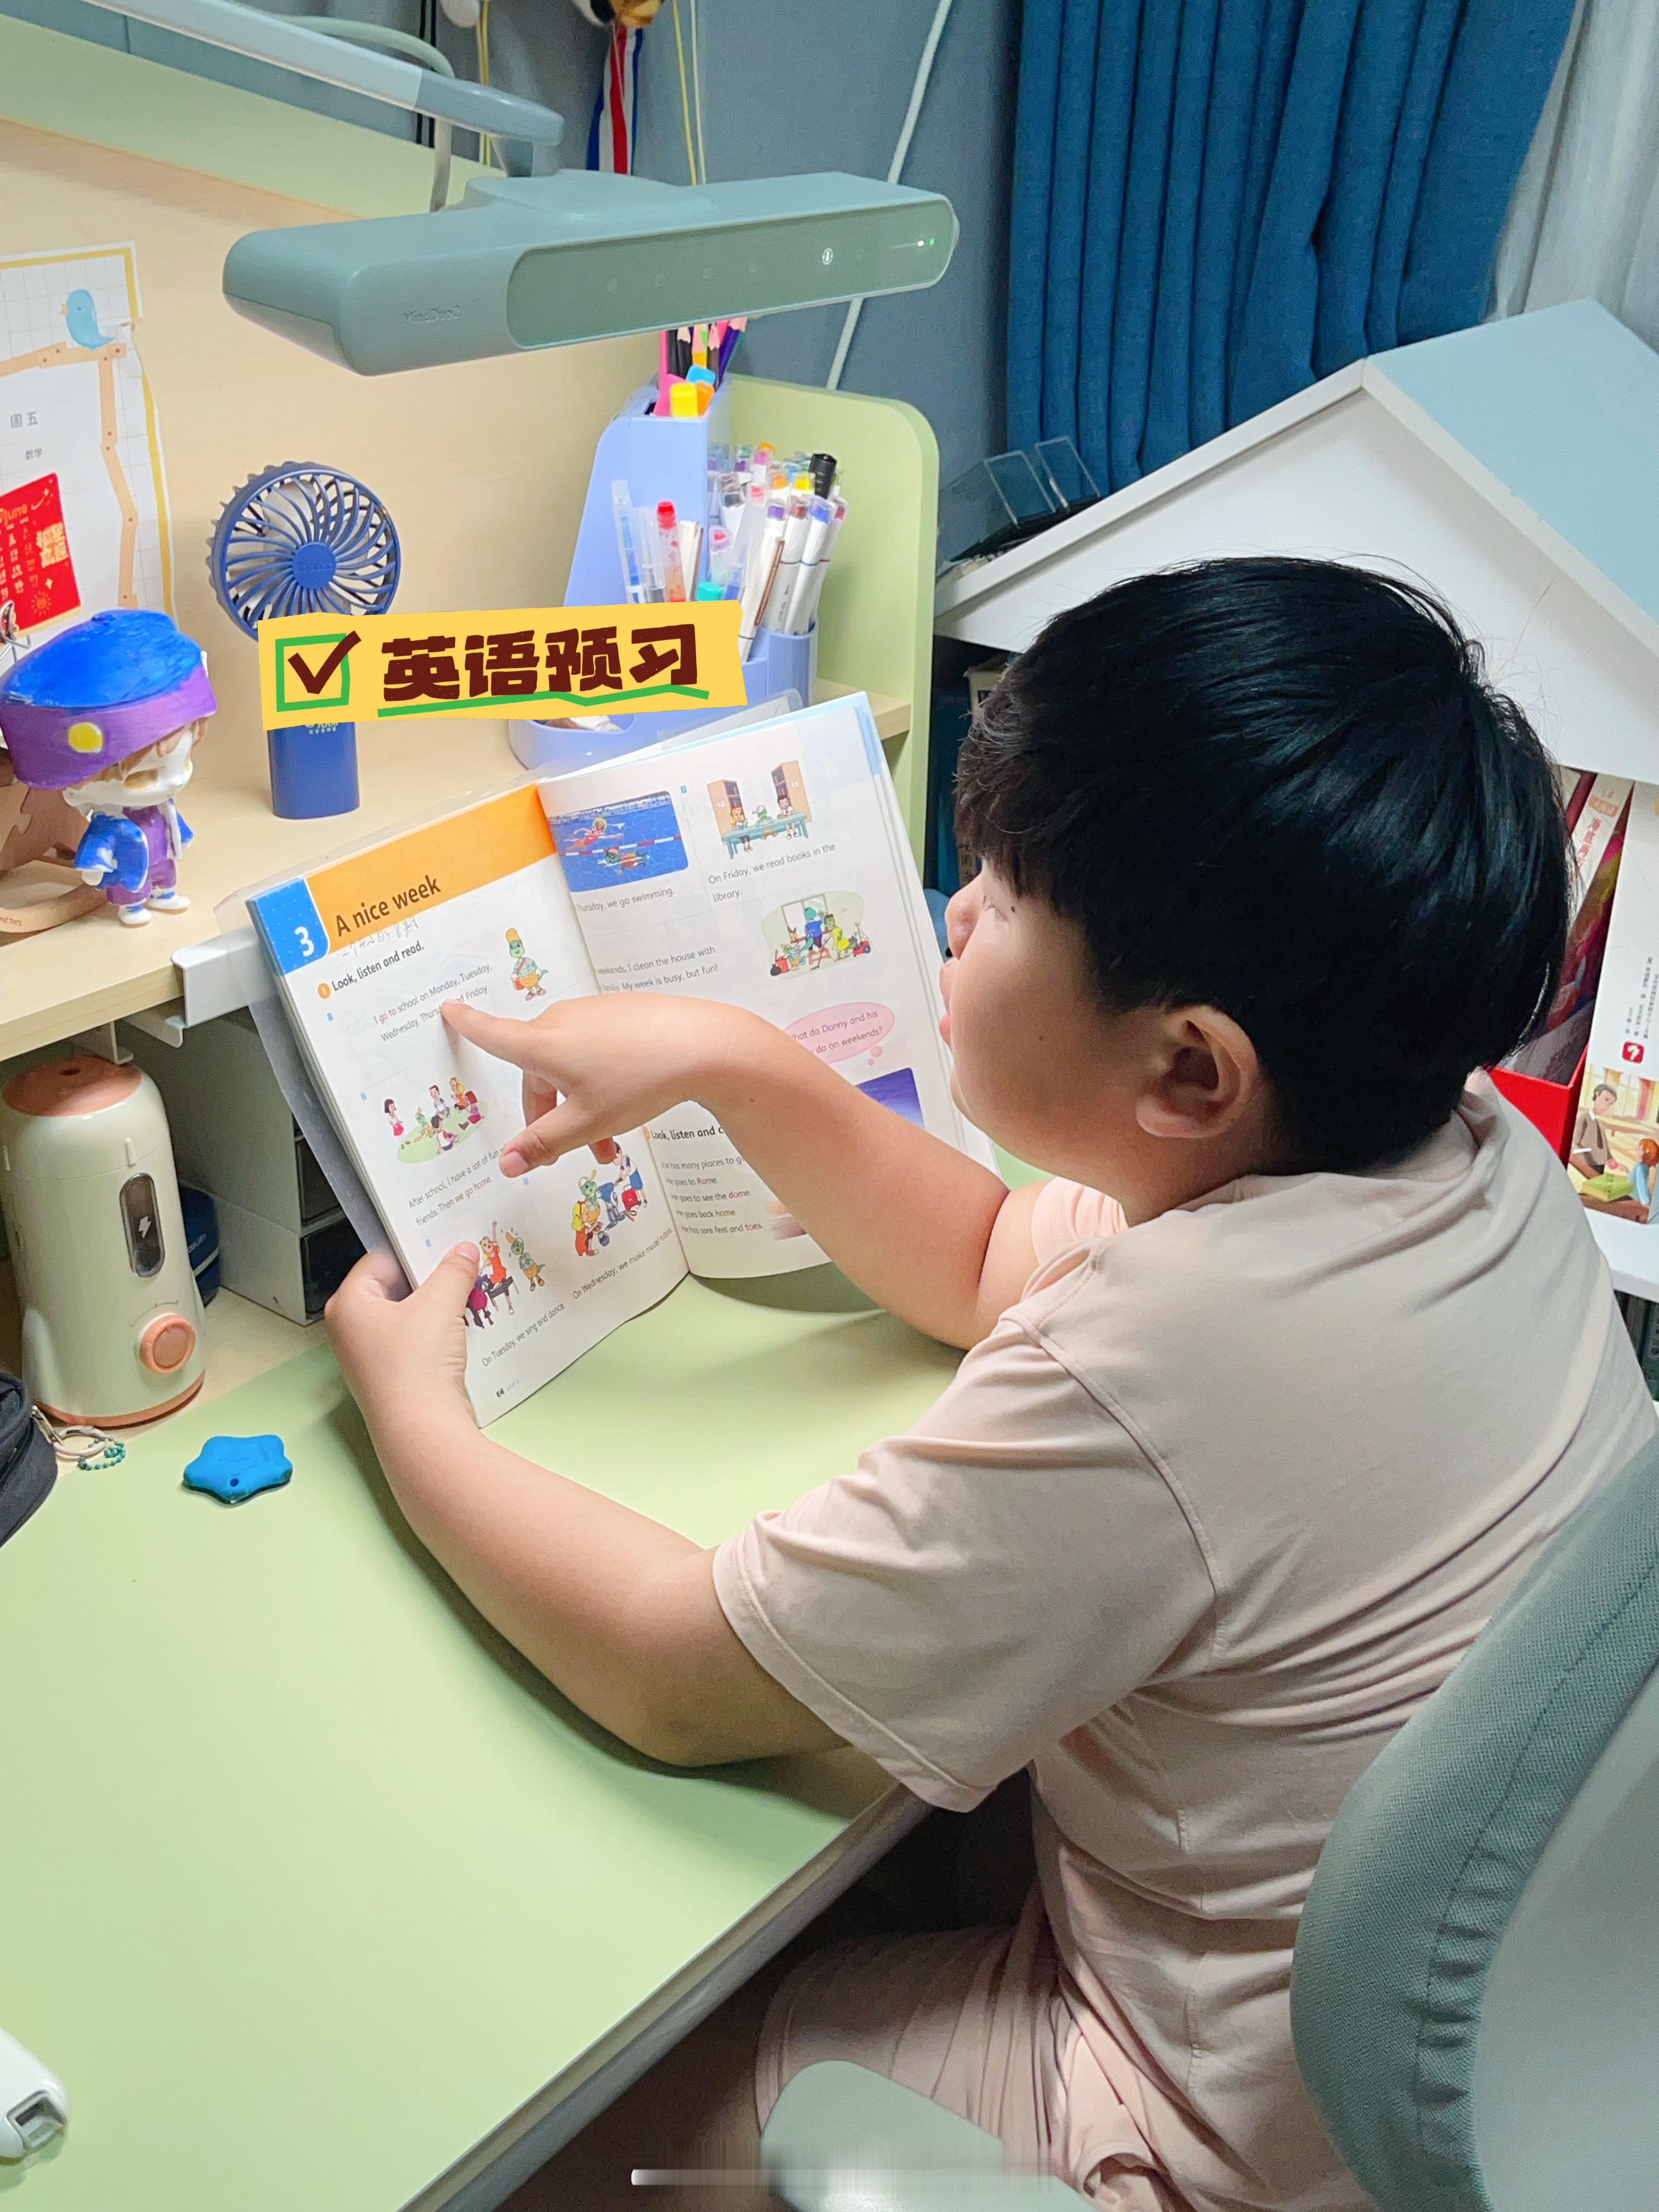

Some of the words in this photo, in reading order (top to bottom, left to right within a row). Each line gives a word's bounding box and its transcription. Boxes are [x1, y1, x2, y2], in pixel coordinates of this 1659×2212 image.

[708, 874, 722, 884] On
[723, 868, 751, 881] Friday,
[752, 863, 765, 872] we
[766, 856, 785, 868] read
[787, 851, 811, 863] books
[812, 847, 821, 856] in
[822, 843, 836, 853] the
[336, 915, 352, 936] A
[352, 902, 391, 928] nice
[392, 874, 442, 910] week
[607, 900, 618, 908] we
[619, 898, 630, 908] go
[631, 888, 675, 904] swimming.
[294, 926, 315, 957] 3
[331, 973, 358, 991] Look,
[357, 961, 382, 979] listen
[383, 951, 401, 967] and
[402, 940, 425, 959] read.
[633, 961, 654, 971] clean
[656, 958, 669, 967] the
[670, 951, 696, 964] house
[697, 945, 716, 957] with
[622, 981, 633, 992] My
[634, 978, 654, 989] week
[656, 977, 663, 985] is
[663, 973, 685, 984] busy,
[686, 968, 701, 978] but
[702, 963, 719, 975] fun!
[374, 1015, 379, 1024] I
[379, 1012, 388, 1024] go
[388, 1008, 397, 1017] to
[397, 996, 419, 1013] school
[420, 992, 430, 1002] on
[429, 978, 460, 996] Monday,
[460, 963, 493, 982] Tuesday,
[380, 1019, 421, 1042] Wednesday,
[420, 1005, 442, 1022] Thurs
[792, 1031, 808, 1041] hat
[810, 1028, 820, 1037] do
[821, 1020, 848, 1033] Danny
[850, 1013, 865, 1025] and
[866, 1011, 878, 1020] his
[816, 1045, 827, 1053] do
[828, 1041, 839, 1050] on
[840, 1026, 883, 1046] weekends?
[651, 1130, 670, 1141] Look,
[670, 1130, 695, 1141] listen
[697, 1125, 715, 1138] and
[681, 1162, 699, 1170] many
[701, 1159, 725, 1169] places
[736, 1156, 744, 1165] g
[409, 1195, 424, 1210] After
[451, 1170, 466, 1184] have
[472, 1160, 481, 1171] lot
[481, 1153, 488, 1165] of
[488, 1149, 500, 1161] fun
[675, 1179, 688, 1187] goes
[438, 1198, 455, 1212] Then
[455, 1193, 465, 1203] we
[465, 1187, 474, 1199] go
[679, 1195, 692, 1204] goes
[715, 1192, 727, 1200] the
[729, 1189, 752, 1199] dome.
[684, 1211, 698, 1220] goes
[698, 1210, 714, 1218] back
[714, 1225, 729, 1234] feet
[730, 1223, 744, 1233] and
[572, 1290, 583, 1300] On
[580, 1267, 619, 1294] Wednesday,
[618, 1261, 629, 1271] we
[629, 1250, 646, 1266] make
[482, 1356, 493, 1367] On
[491, 1337, 517, 1359] Tuesday,
[516, 1330, 527, 1342] we
[525, 1322, 538, 1336] sing
[537, 1314, 548, 1328] and
